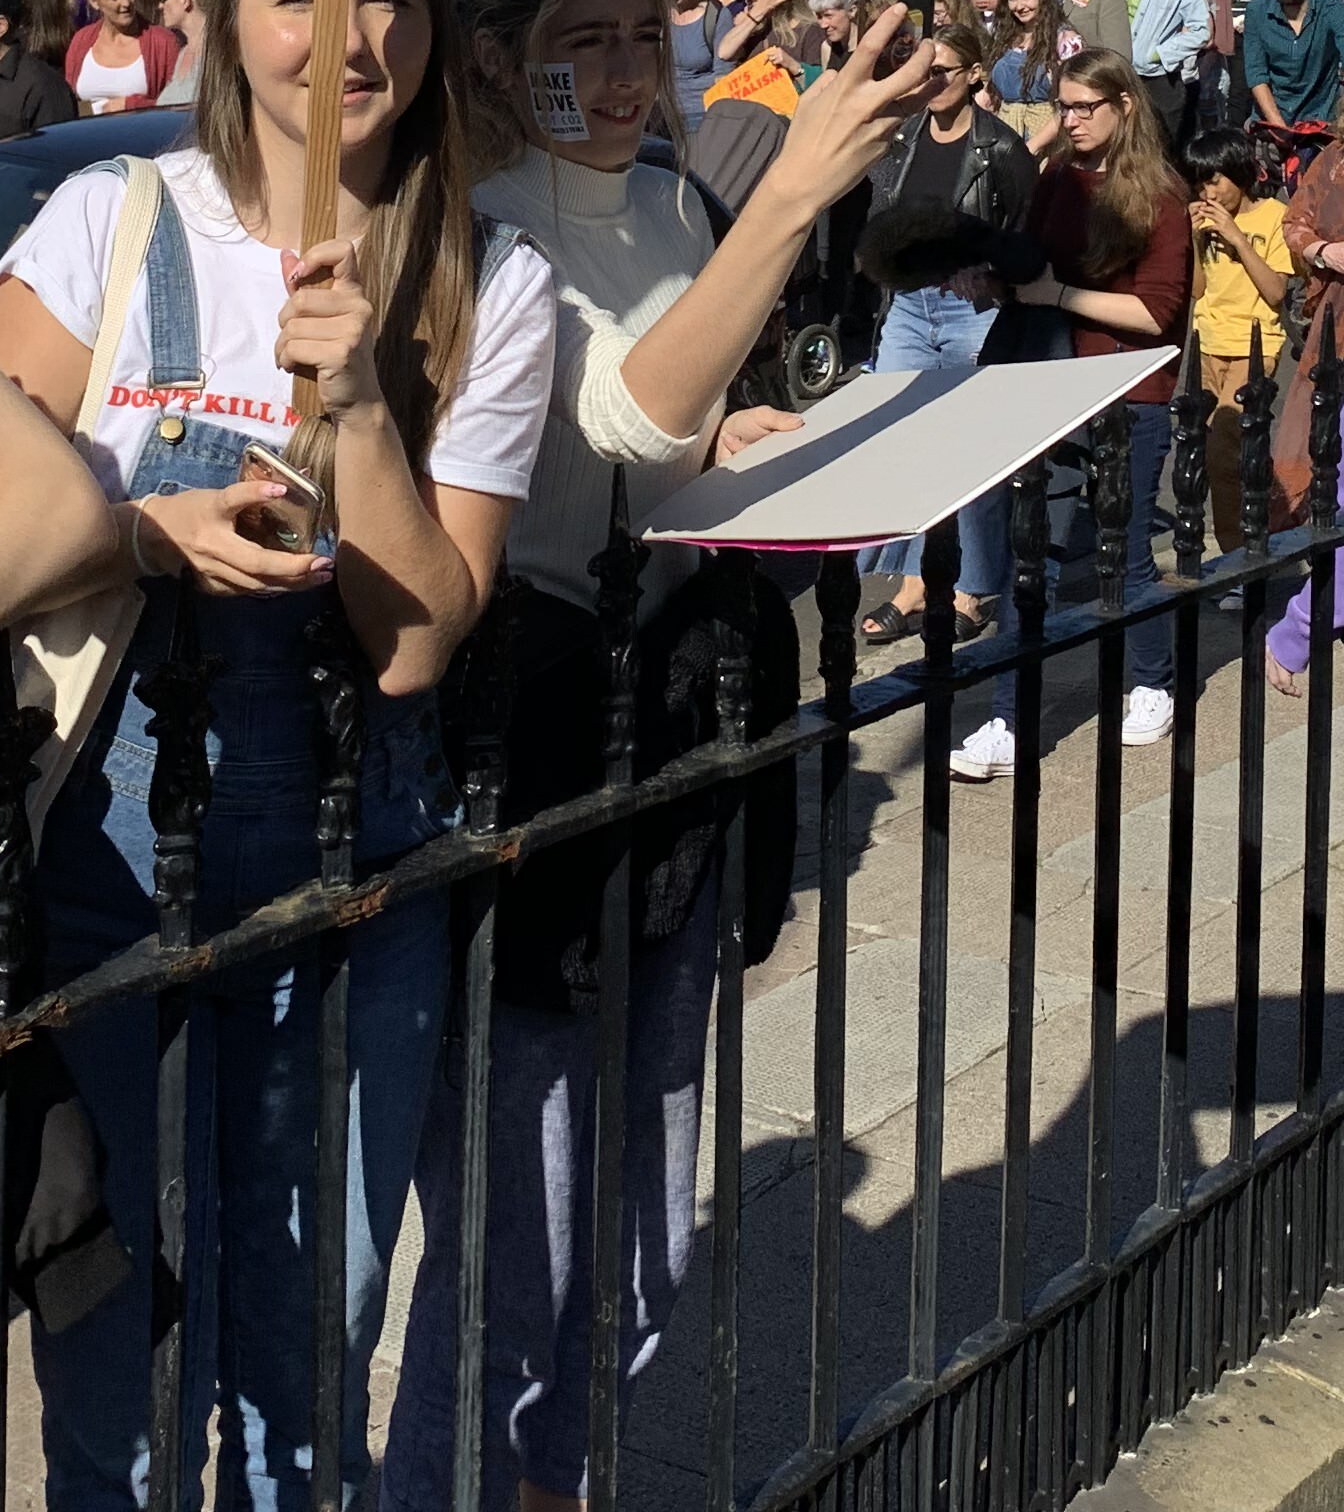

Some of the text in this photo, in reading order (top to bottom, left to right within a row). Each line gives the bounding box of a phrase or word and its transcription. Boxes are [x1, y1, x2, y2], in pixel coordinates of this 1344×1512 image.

[727, 70, 751, 91] IT'S
[107, 385, 200, 412] DON'T
[203, 392, 275, 424] KILL
